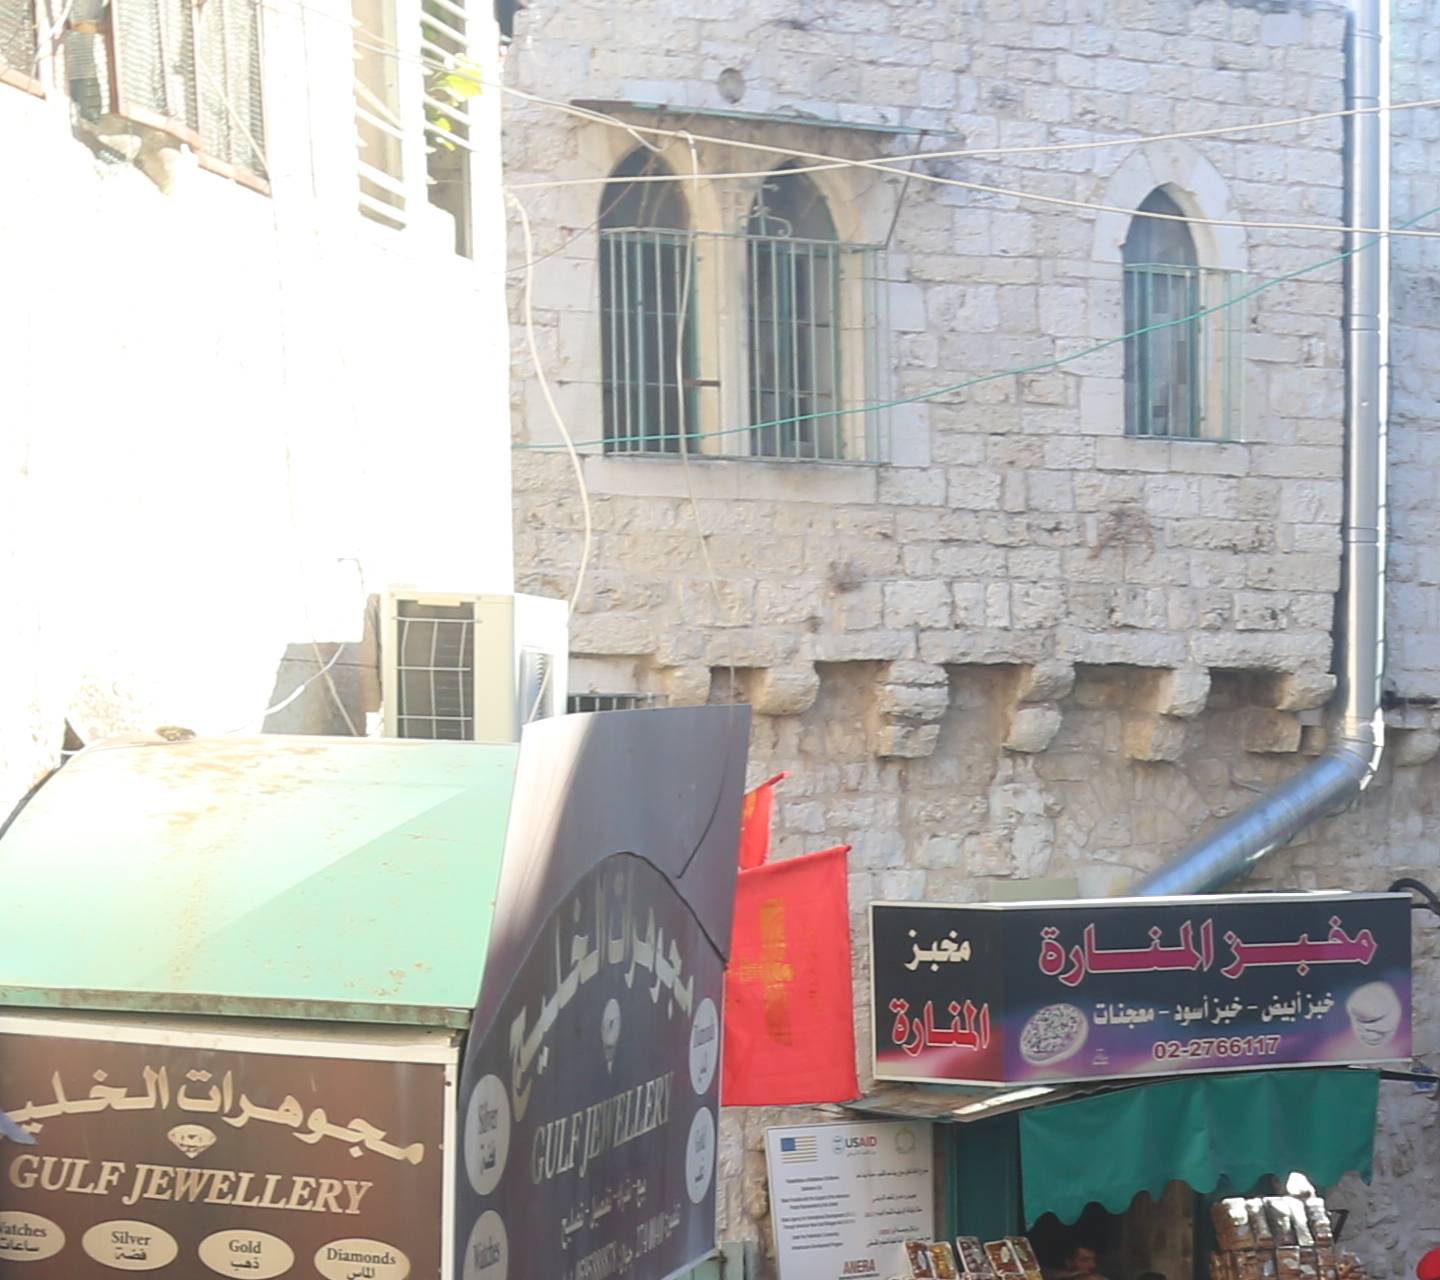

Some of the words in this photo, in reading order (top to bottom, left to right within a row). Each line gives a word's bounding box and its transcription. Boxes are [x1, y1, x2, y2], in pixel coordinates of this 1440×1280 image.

[904, 929, 972, 972] مخبز
[1038, 918, 1214, 987] المنارة
[1220, 915, 1378, 980] مخبز
[1093, 1002, 1155, 1030] معجنات
[1173, 995, 1210, 1027] أسود
[1213, 997, 1243, 1025] خبز
[1261, 991, 1302, 1023] أبيض
[1304, 992, 1335, 1018] خبز
[889, 998, 991, 1058] المنارة
[1153, 1035, 1282, 1062] 02-2766117
[176, 1068, 425, 1166] مجوهرات
[532, 1110, 584, 1185] GULF
[579, 1071, 675, 1178] JEWELLERY
[845, 1136, 877, 1149] USAID
[9, 1154, 129, 1194] GULF
[121, 1163, 374, 1215] JEWELLERY
[111, 1231, 150, 1248] Silver
[229, 1239, 262, 1256] Gold
[115, 1246, 148, 1262] فضة
[231, 1256, 260, 1271] ذهب
[327, 1248, 397, 1266] Diamonds
